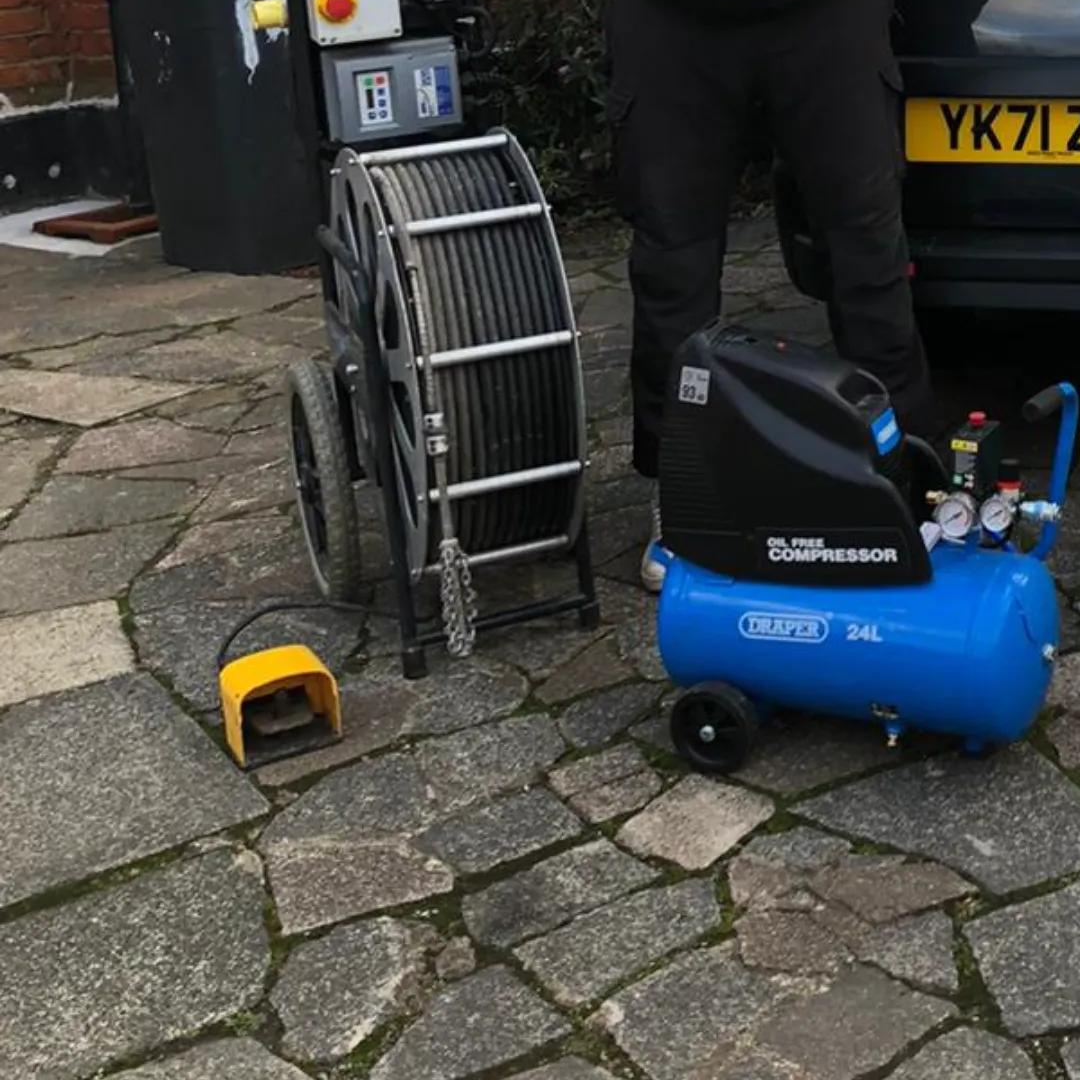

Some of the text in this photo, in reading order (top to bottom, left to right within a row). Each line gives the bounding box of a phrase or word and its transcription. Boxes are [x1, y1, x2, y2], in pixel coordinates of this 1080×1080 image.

[940, 103, 1051, 151] YK71
[766, 536, 826, 548] OIL FREE
[768, 547, 899, 563] COMPRESSOR
[747, 616, 884, 643] DRAPER 24L
